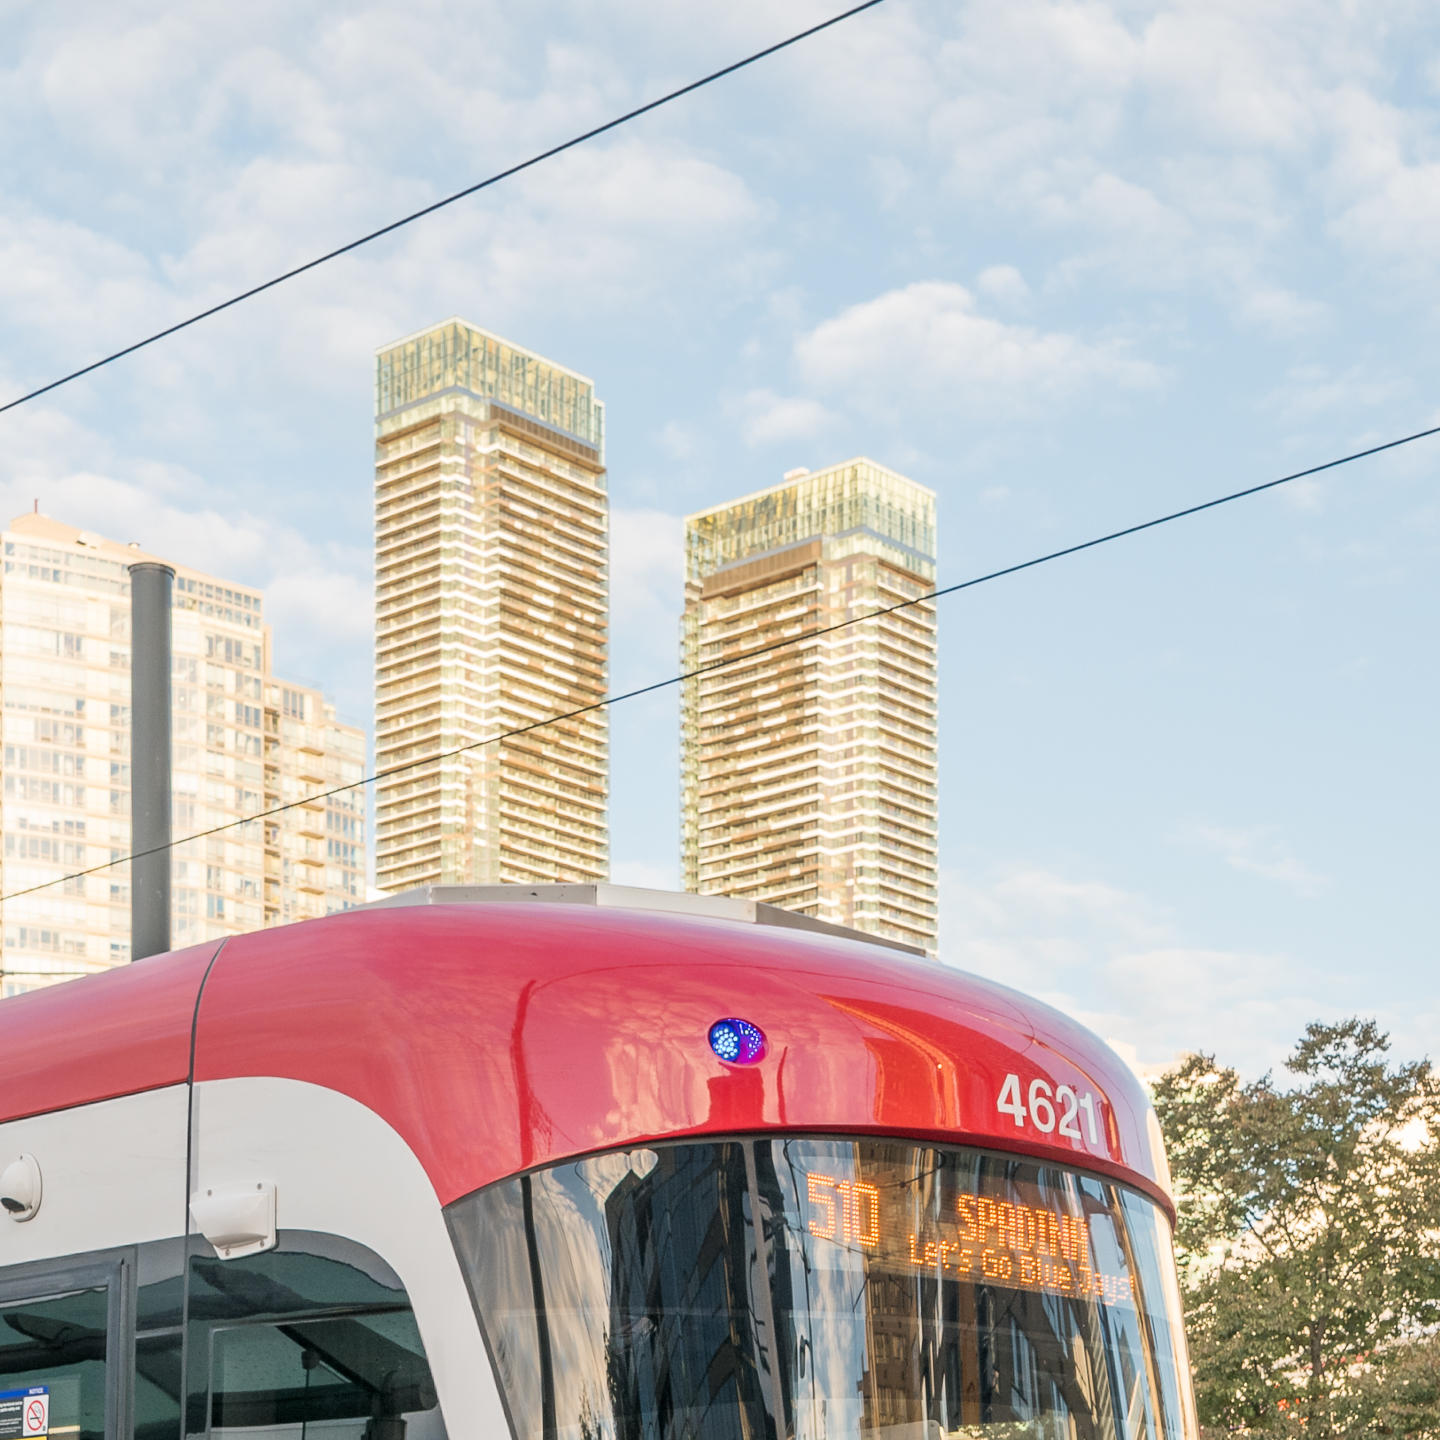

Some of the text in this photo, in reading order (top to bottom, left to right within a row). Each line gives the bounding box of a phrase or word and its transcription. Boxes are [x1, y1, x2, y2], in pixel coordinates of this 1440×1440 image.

[997, 1073, 1098, 1145] 4621
[807, 1173, 879, 1247] 510
[958, 1194, 1088, 1262] SPADINA
[909, 1234, 973, 1273] Let's
[983, 1248, 1013, 1279] Go
[1020, 1254, 1071, 1290] Blue
